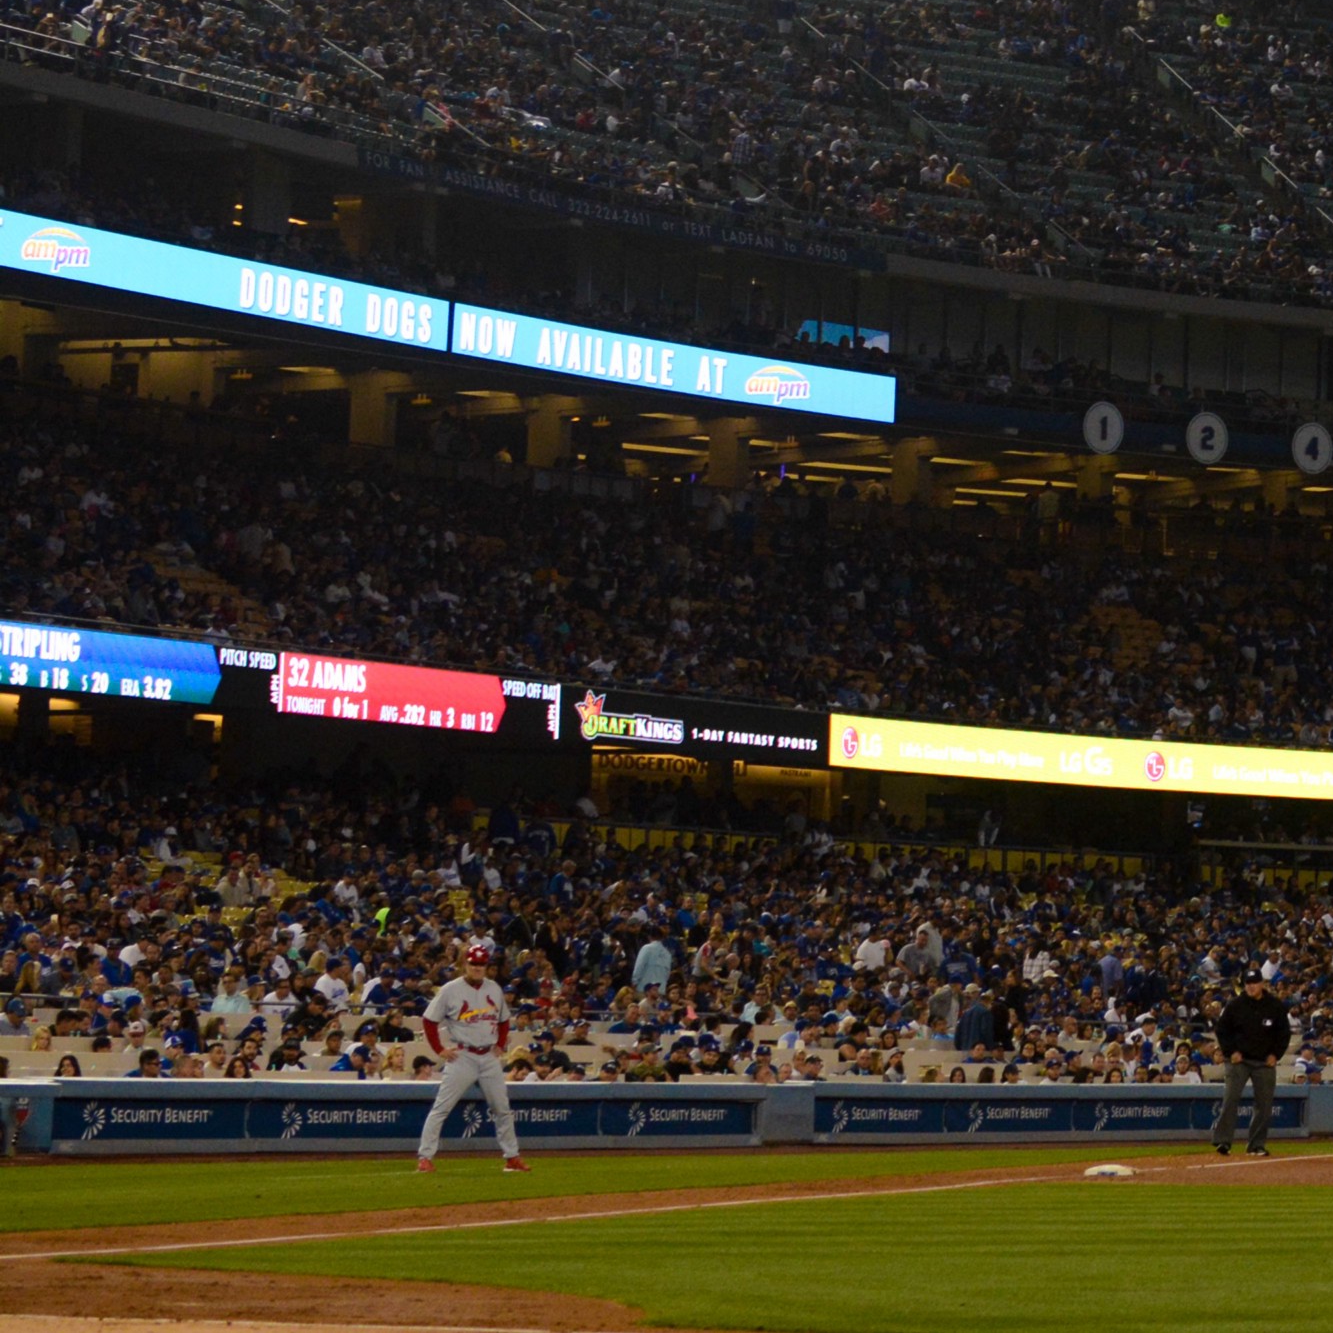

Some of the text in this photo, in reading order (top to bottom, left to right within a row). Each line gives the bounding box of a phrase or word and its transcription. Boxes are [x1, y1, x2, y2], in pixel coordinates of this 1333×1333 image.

[446, 171, 520, 199] ASSISTANCE
[529, 189, 557, 208] CALL
[662, 222, 675, 231] or
[684, 222, 711, 238] TEXT
[722, 229, 774, 249] LADFAN
[785, 241, 796, 253] to
[807, 244, 847, 262] 69050
[22, 239, 90, 272] ampm
[240, 267, 811, 404] DODGER DOGS NOW AVAILABLE AT ampm
[1201, 427, 1215, 450] 2
[1305, 437, 1319, 460] 4
[0, 624, 81, 662] TRIPLING
[220, 648, 277, 670] PITCH SPEED
[52, 667, 69, 690] 18
[91, 672, 109, 693] 20
[121, 678, 140, 697] ERA
[288, 658, 366, 693] 32 ADAMS
[270, 674, 280, 704] MPH
[503, 680, 558, 700] SPEED OFF BAT
[286, 696, 325, 715] TONIGHT
[333, 697, 341, 717] 0
[342, 698, 359, 719] for
[361, 699, 368, 720] 1
[380, 705, 398, 721] AVG
[430, 711, 441, 727] HR
[446, 708, 454, 728] 3
[461, 713, 475, 729] RBI
[480, 712, 493, 732] 12
[547, 704, 556, 731] MPH
[582, 714, 684, 742] DRAFTKINGS
[692, 728, 818, 751] 1-DAY FANTASY SPORTS
[861, 733, 883, 758] LG
[1060, 750, 1081, 773] LG
[1168, 757, 1193, 780] LG
[110, 1107, 164, 1123] SECURITY
[306, 1107, 355, 1123] SECURITY
[649, 1107, 689, 1122] SECURITY
[851, 1106, 888, 1121] SECURITY
[986, 1106, 1020, 1120] SECURITY
[1111, 1105, 1142, 1118] SECURITY
